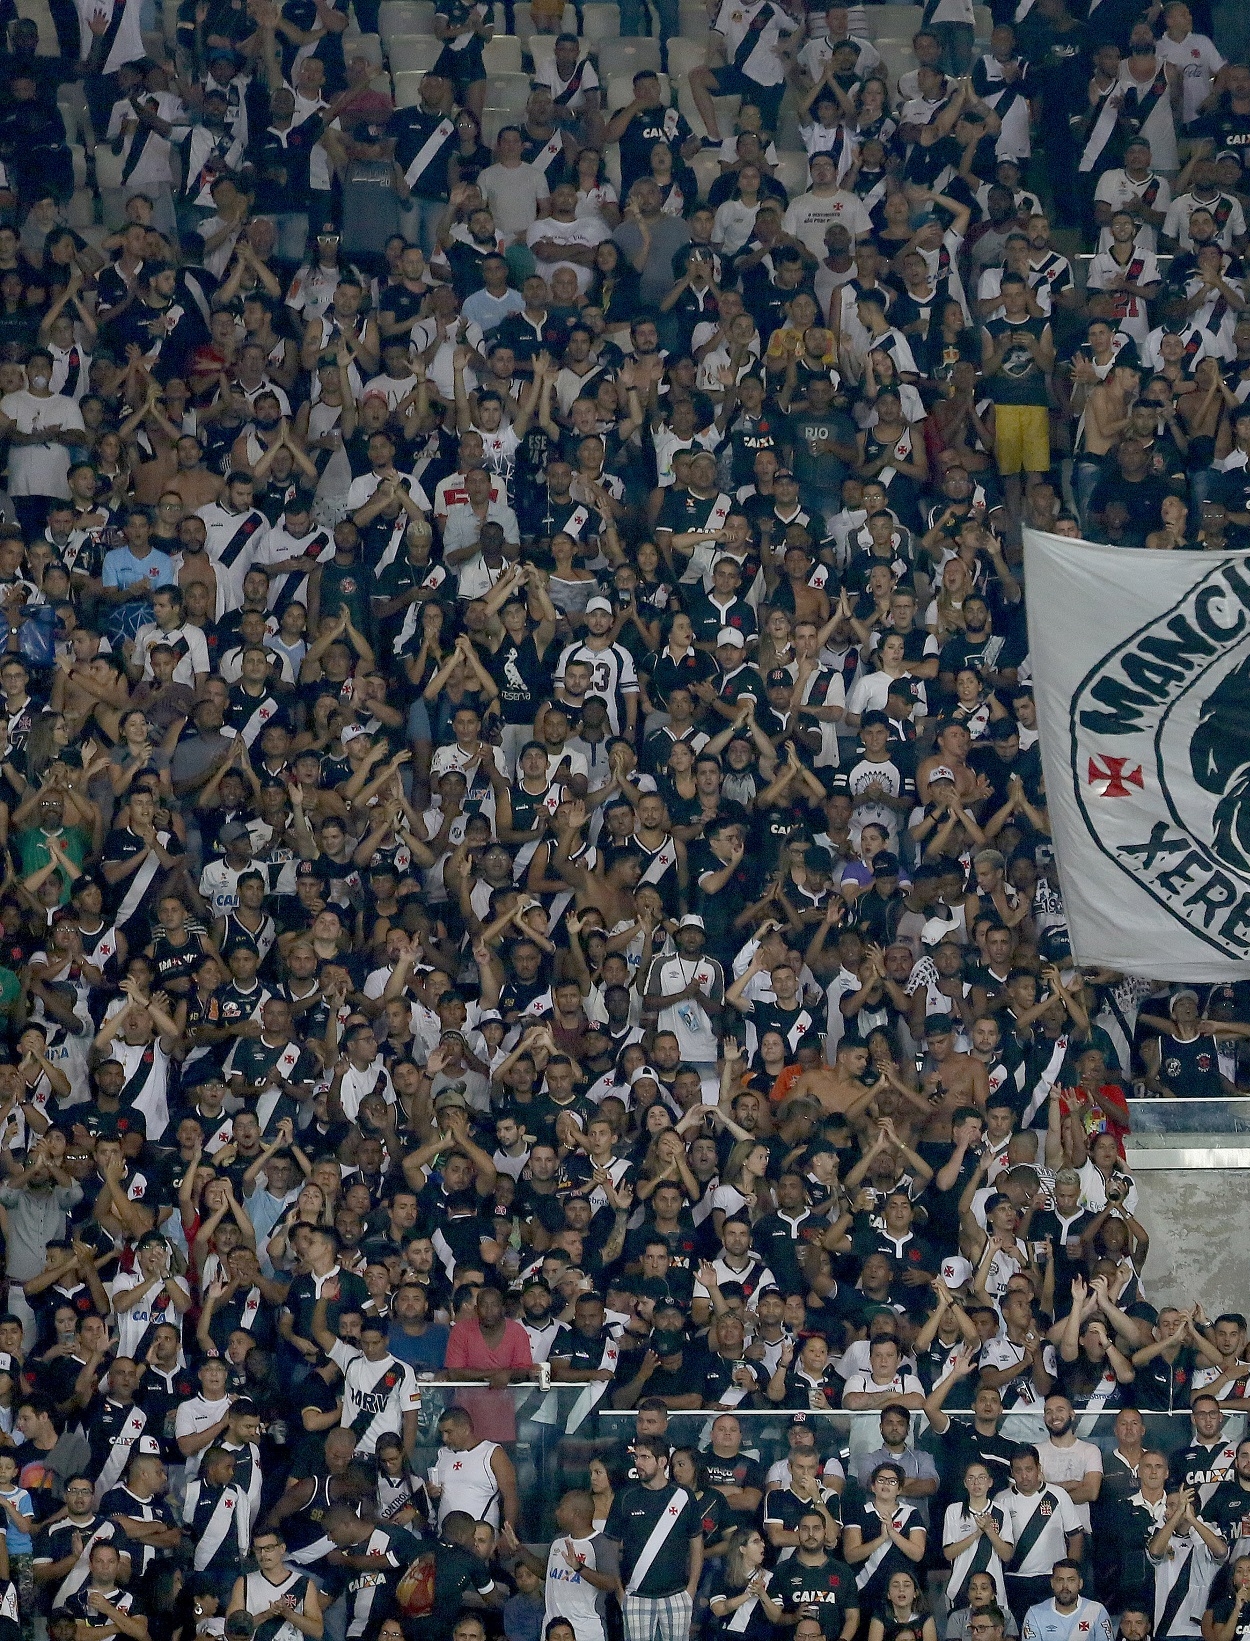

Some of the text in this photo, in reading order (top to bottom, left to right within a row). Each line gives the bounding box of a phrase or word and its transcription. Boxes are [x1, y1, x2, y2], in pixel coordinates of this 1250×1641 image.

[805, 427, 830, 441] RIO
[502, 690, 531, 701] reserva
[217, 894, 239, 907] CAI
[1186, 1469, 1236, 1485] CAIXA
[381, 1492, 410, 1520] CONTROL
[348, 1572, 387, 1593] CAIXA
[791, 1590, 837, 1604] CAIXA
